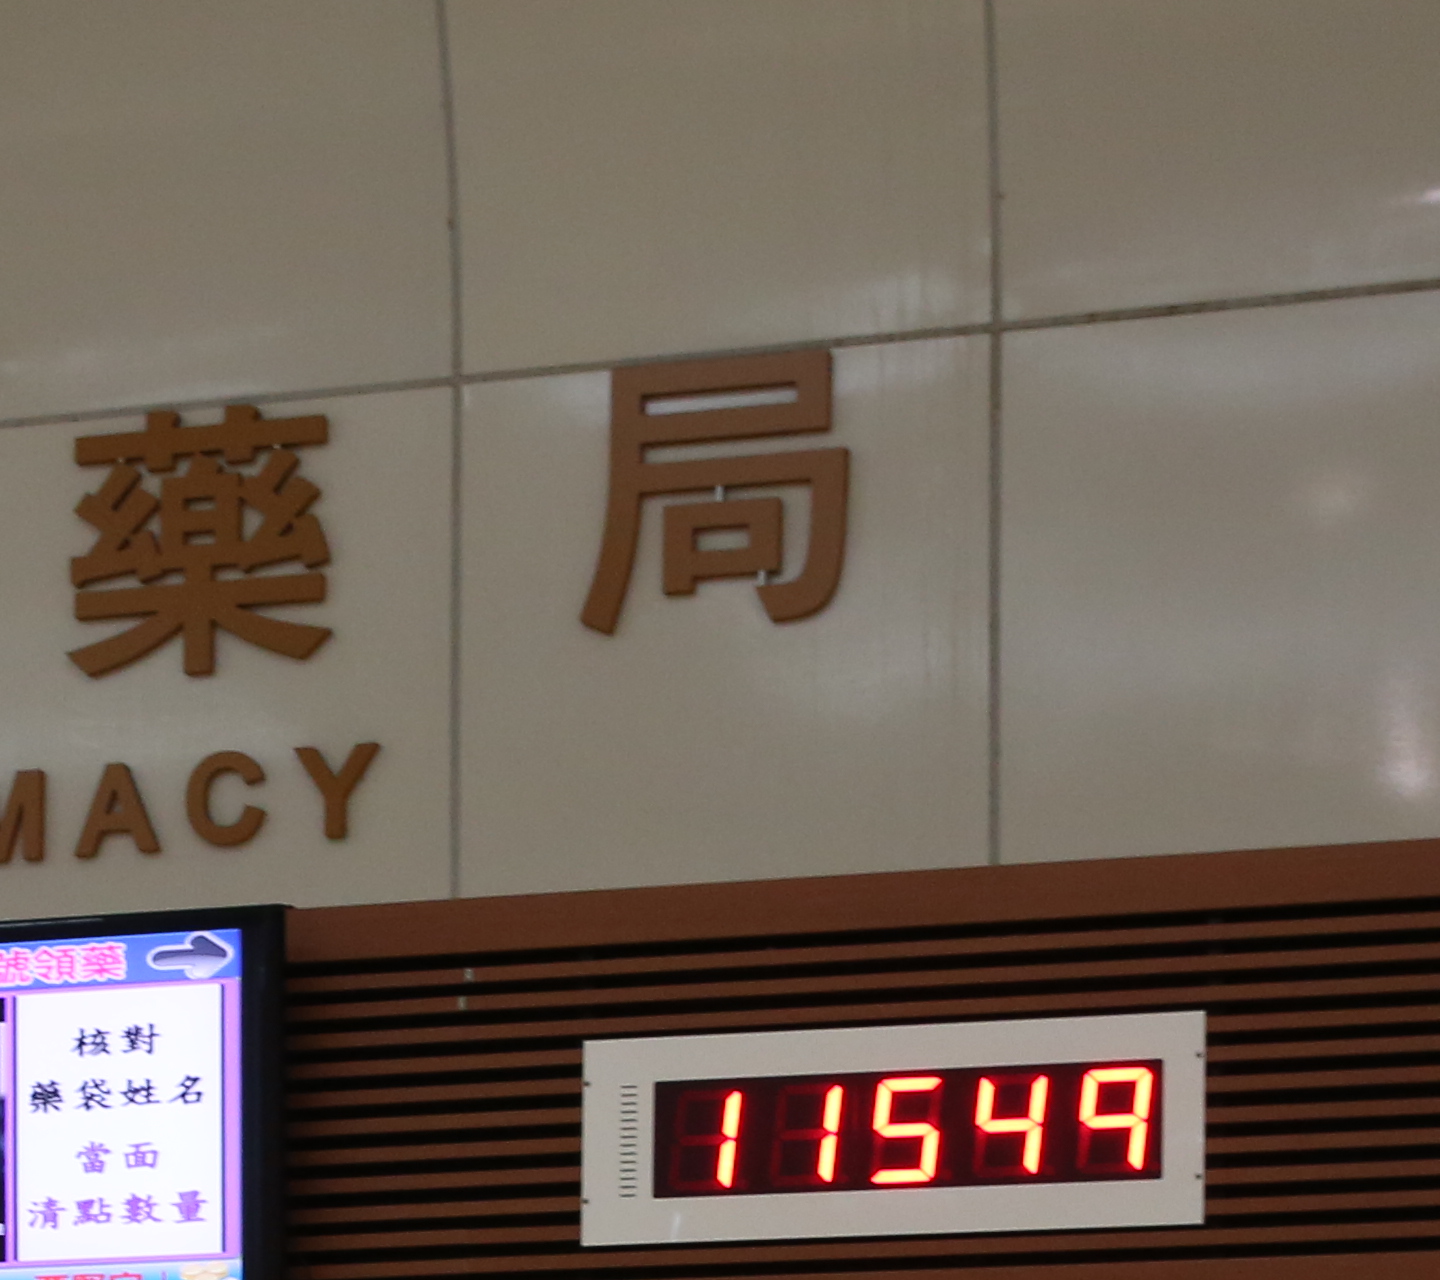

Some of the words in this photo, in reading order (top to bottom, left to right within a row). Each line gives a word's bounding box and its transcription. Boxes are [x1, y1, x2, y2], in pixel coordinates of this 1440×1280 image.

[72, 1023, 161, 1057] 核對
[29, 1072, 206, 1114] 藥袋姓名
[712, 1067, 1154, 1190] 11549
[75, 1141, 161, 1175] 當面
[27, 1190, 208, 1230] 清點數量
